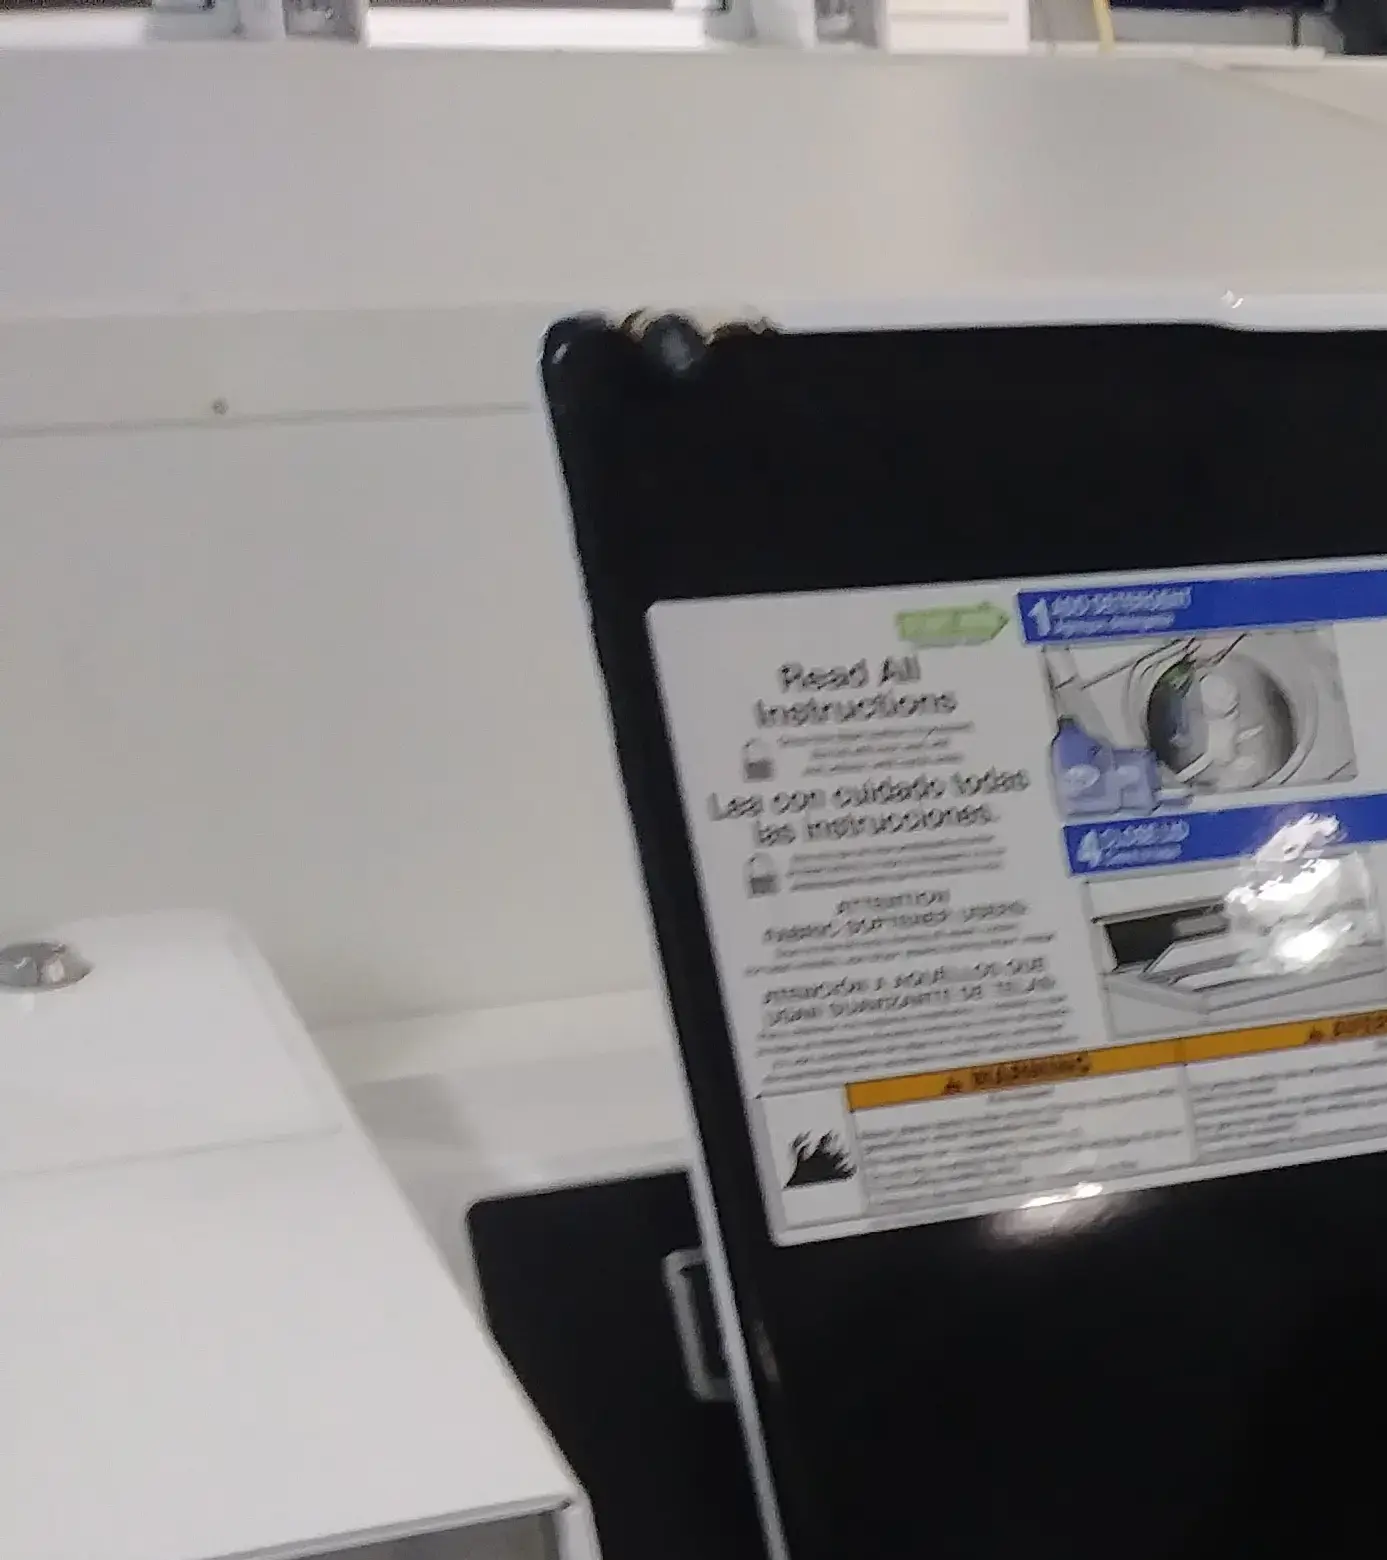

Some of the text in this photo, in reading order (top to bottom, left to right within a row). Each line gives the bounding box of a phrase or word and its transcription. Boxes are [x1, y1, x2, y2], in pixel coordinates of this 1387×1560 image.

[1027, 597, 1051, 637] 1
[777, 652, 921, 692] Read All
[754, 690, 958, 727] Instructions
[709, 766, 1030, 821] Lea con cuidado todas
[754, 818, 797, 847] las
[1077, 829, 1101, 868] 4
